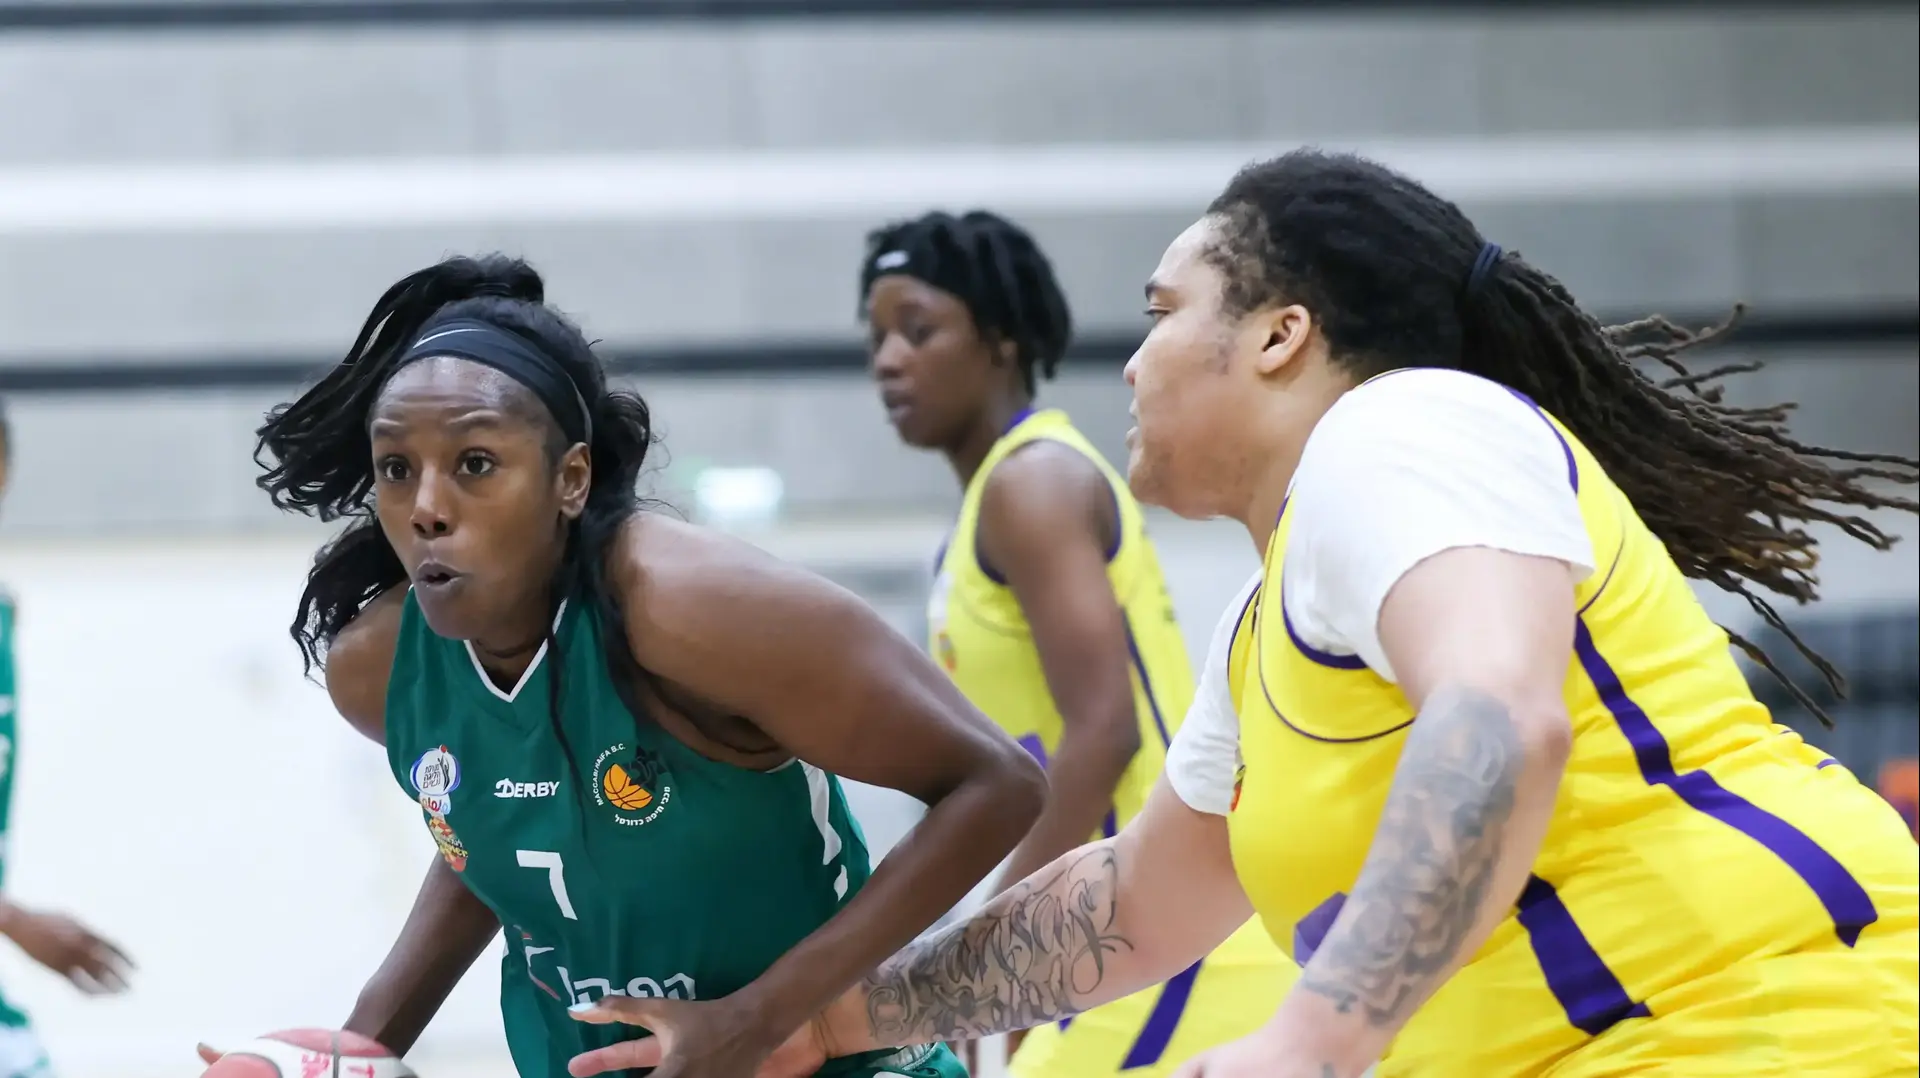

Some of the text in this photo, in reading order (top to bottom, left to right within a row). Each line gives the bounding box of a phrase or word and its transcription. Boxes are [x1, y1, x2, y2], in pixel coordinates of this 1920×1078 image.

[593, 743, 626, 806] MACCABI HAIFA B.C.
[493, 777, 560, 799] DERBY
[614, 813, 645, 826] כדורסל
[645, 804, 665, 823] חיפה
[515, 849, 578, 921] 7
